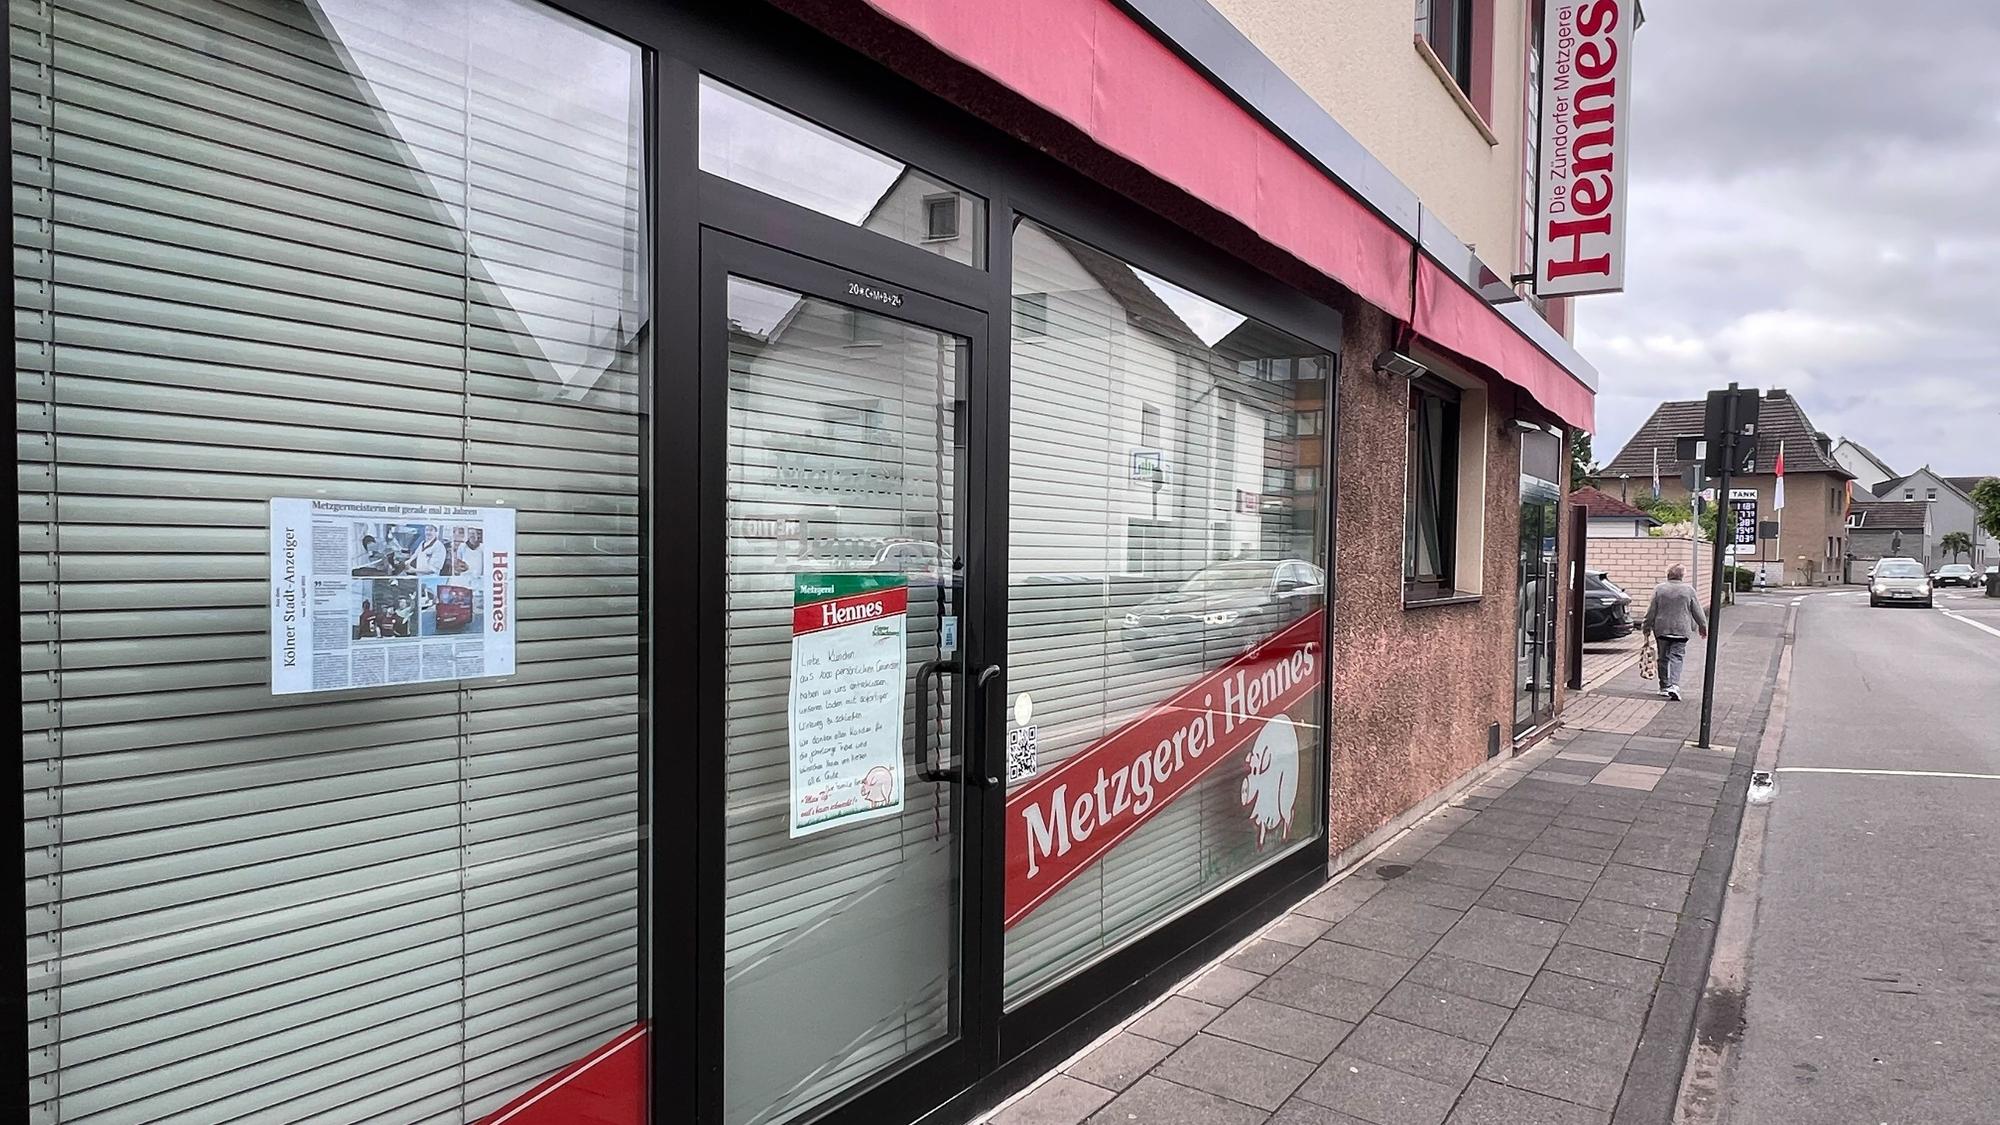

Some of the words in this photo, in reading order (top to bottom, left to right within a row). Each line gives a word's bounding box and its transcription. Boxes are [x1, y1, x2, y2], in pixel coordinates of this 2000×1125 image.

[1553, 4, 1575, 92] Metzgerei
[1547, 0, 1619, 282] Hennes
[1551, 96, 1569, 179] Zündorfer
[1550, 186, 1565, 214] Die
[312, 500, 387, 512] Metzgermeisterin
[388, 505, 400, 513] mit
[402, 506, 428, 516] gerade
[452, 507, 478, 516] Jahren
[283, 527, 298, 622] Stadt-Anzeiger
[492, 551, 508, 632] Hennes
[800, 584, 835, 596] Metzgerei
[822, 600, 883, 626] Hennes
[283, 624, 296, 668] Kölner
[828, 648, 855, 662] Kunden
[1021, 693, 1216, 879] Metzgerei
[1222, 642, 1315, 734] Hennes
